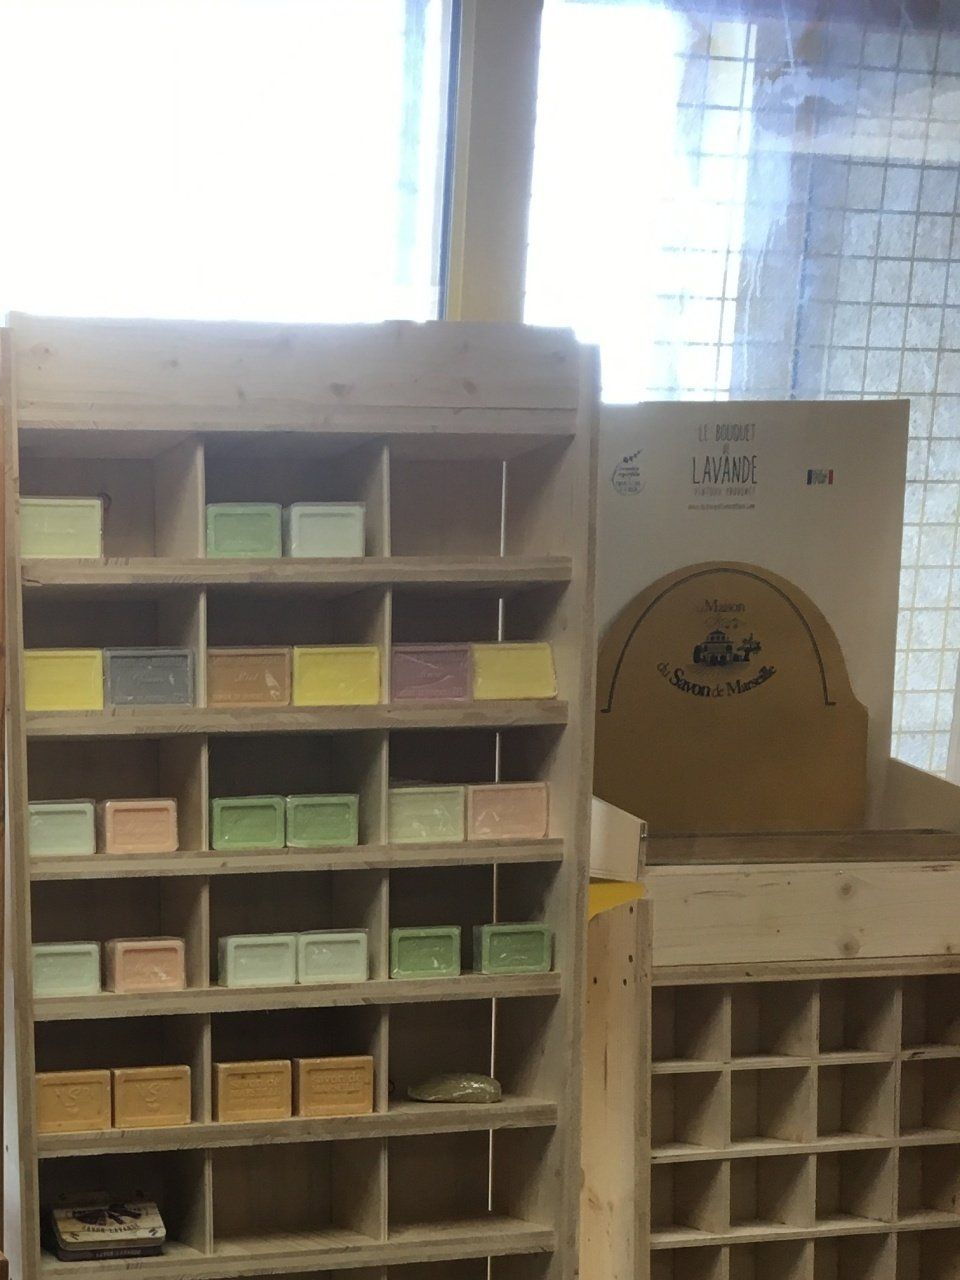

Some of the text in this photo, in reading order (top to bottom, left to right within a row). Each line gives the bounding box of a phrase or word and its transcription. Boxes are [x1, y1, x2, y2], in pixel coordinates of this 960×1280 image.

[692, 455, 758, 484] LAVANDE
[669, 667, 712, 698] Savon
[725, 665, 778, 696] Marseille
